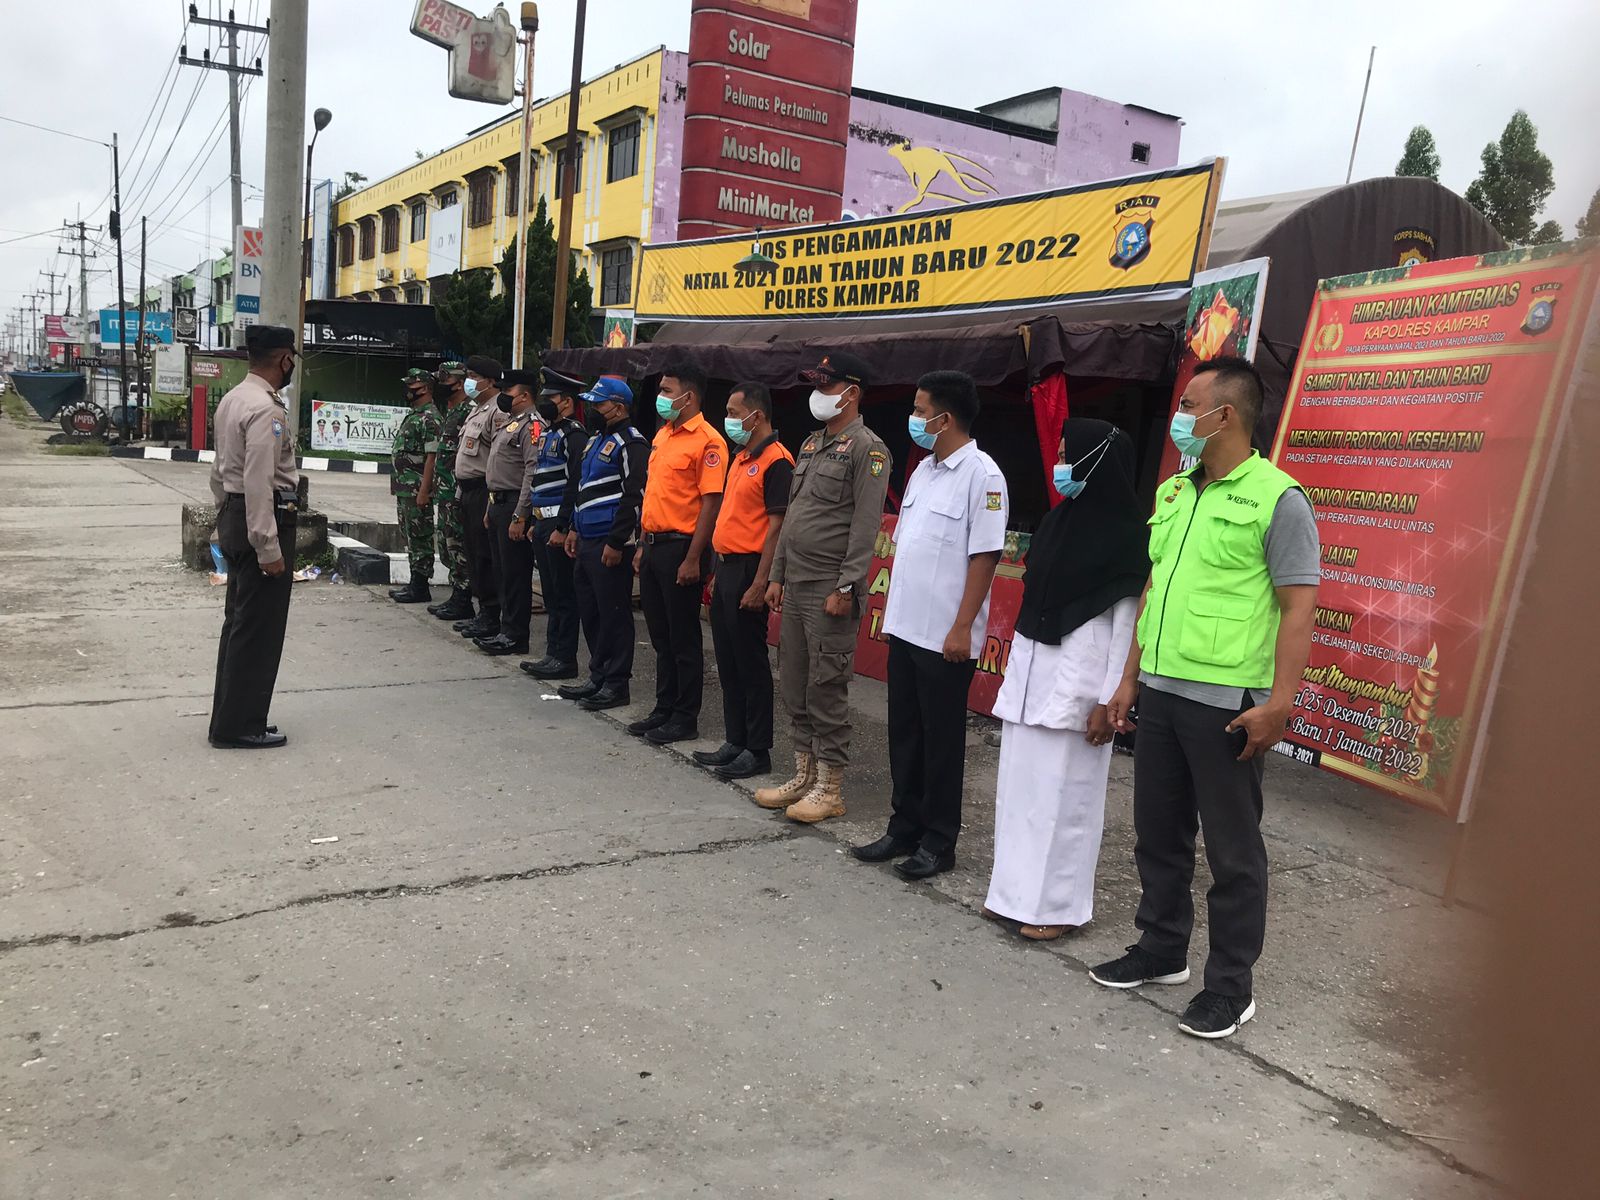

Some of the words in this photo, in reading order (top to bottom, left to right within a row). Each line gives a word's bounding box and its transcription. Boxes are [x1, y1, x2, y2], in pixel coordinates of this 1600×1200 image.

[419, 14, 460, 39] PAS
[423, 0, 473, 30] PASTI
[728, 29, 771, 60] Solar
[724, 84, 770, 111] Pelumas
[774, 96, 828, 125] Pertamina
[720, 135, 801, 172] Musholla
[717, 187, 815, 224] MiniMarket
[1119, 197, 1155, 212] RIAU
[793, 219, 952, 258] PENGAMANAN
[241, 263, 262, 278] BN
[684, 271, 729, 290] NATAL
[733, 268, 778, 289] 2021
[783, 264, 822, 286] DAN
[829, 255, 904, 283] TAHUN
[912, 246, 987, 276] BARU
[996, 233, 1081, 266] 2022
[764, 286, 828, 310] POLRES
[833, 280, 920, 308] KAMPAR
[1535, 283, 1560, 293] RIAU
[240, 300, 258, 308] ATM
[1350, 296, 1425, 324] HIMBAUAN
[1425, 281, 1521, 318] KAMTIBMAS
[1363, 321, 1432, 341] KAPOLRES
[1434, 314, 1490, 335] KAMPAR
[1345, 345, 1362, 354] PADA
[1361, 343, 1395, 354] PERAYAAN
[1395, 342, 1413, 351] NATAL
[1414, 340, 1429, 350] 2021
[1429, 339, 1444, 349] DAN
[1445, 337, 1467, 347] TAHUN
[1467, 334, 1487, 345] BARU
[1488, 332, 1506, 343] 2022
[1303, 373, 1348, 392] SAMBUT
[1346, 371, 1382, 391] NATAL
[1381, 369, 1410, 390] DAN
[1410, 366, 1452, 388] TAHUN
[1451, 363, 1492, 386] BARU
[62, 401, 104, 420] TAMBAL
[1299, 396, 1332, 407] DENGAN
[1332, 395, 1379, 407] BERIBADAH
[1380, 393, 1399, 406] DAN
[1400, 393, 1444, 405] KEGIATAN
[1445, 391, 1484, 404] POSITIF
[1287, 428, 1345, 448] MENGIKUTI
[1343, 429, 1404, 450] PROTOKOL
[1405, 430, 1485, 452] KESEHATAN
[1285, 453, 1305, 463] PADA
[1305, 453, 1333, 464] SETIAP
[1333, 454, 1373, 466] KEGIATAN
[1374, 456, 1398, 467] YANG
[1399, 456, 1454, 469] DILAKUKAN
[1344, 489, 1419, 515] KENDARAAN
[1327, 512, 1377, 527] PERATURAN
[1377, 517, 1401, 531] LALU
[1401, 520, 1435, 533] LINTAS
[1323, 544, 1359, 567] JAUHI
[1319, 568, 1341, 582] ASAN
[1340, 571, 1360, 585] DAN
[1359, 576, 1405, 594] KONSUMSI
[1404, 582, 1437, 599] MIRAS
[1314, 606, 1354, 633] KUKAN
[1311, 631, 1320, 643] GI
[1320, 633, 1362, 654] KEJAHATAN
[1362, 643, 1396, 662] SEKECIL
[1395, 652, 1433, 671] APAPUN
[1301, 665, 1328, 683] nat
[1325, 664, 1414, 709] Menyambut
[1293, 687, 1308, 708] al
[1304, 692, 1323, 713] 25
[1322, 698, 1385, 733] Desember
[1384, 717, 1421, 745] 2021
[1292, 716, 1323, 742] Baru
[1324, 727, 1334, 745] 1
[1332, 730, 1383, 764] Januari
[1385, 747, 1424, 777] 2022
